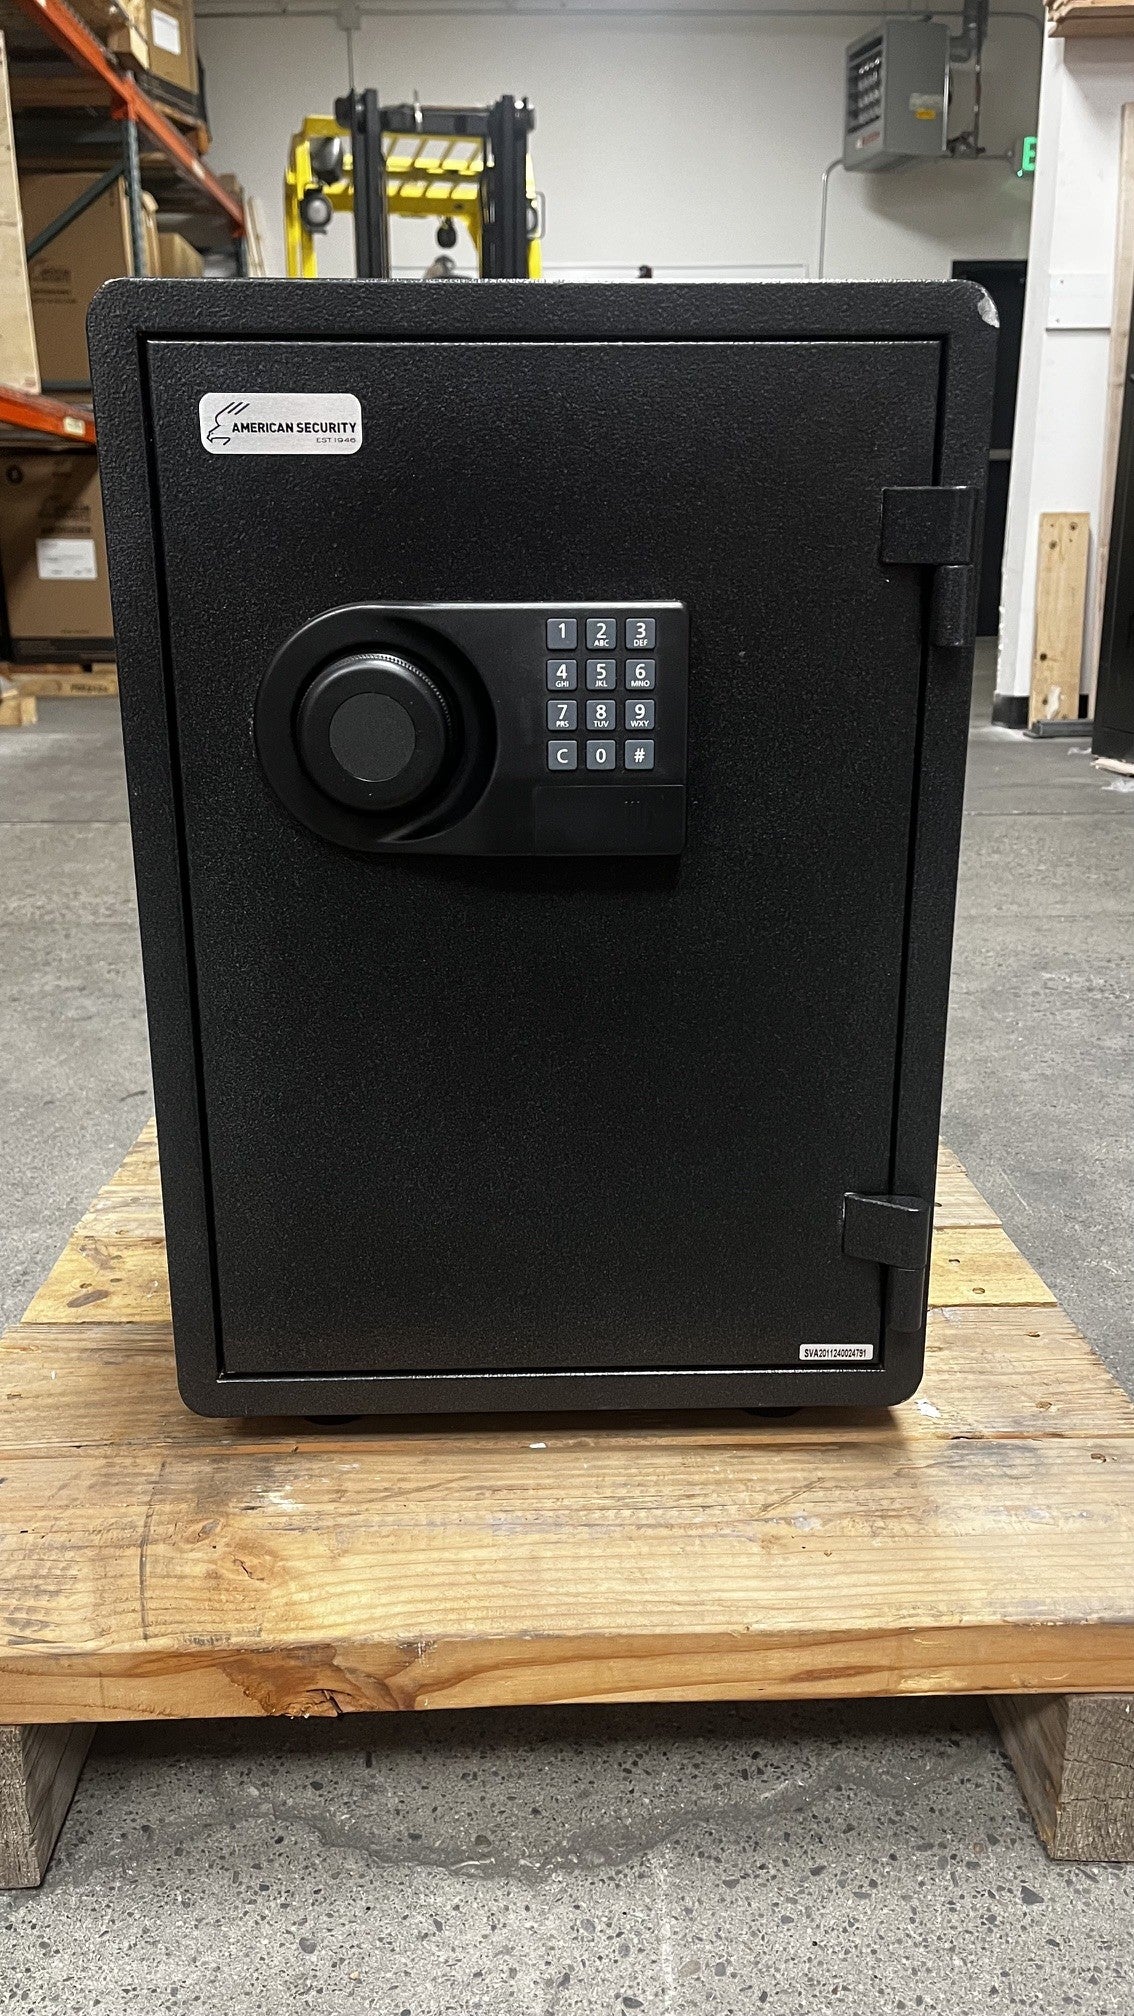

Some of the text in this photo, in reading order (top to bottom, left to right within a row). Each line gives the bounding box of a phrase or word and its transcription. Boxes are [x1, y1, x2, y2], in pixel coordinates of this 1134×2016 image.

[232, 422, 357, 433] AMERICAN SECURITY
[558, 622, 566, 639] 1
[596, 622, 607, 639] 2
[635, 622, 646, 639] 3
[593, 639, 609, 647] ABC
[633, 639, 648, 647] DEF
[556, 664, 568, 679] 4
[596, 663, 607, 679] 5
[635, 663, 646, 679] 6
[555, 680, 569, 688] GHI
[595, 680, 608, 688] JKL
[557, 704, 568, 720] 7
[595, 704, 607, 720] 8
[634, 704, 646, 719] 9
[556, 720, 569, 728] PRS
[593, 720, 609, 728] TUV
[556, 748, 569, 764] C
[595, 748, 607, 764] 0
[633, 747, 646, 763] #
